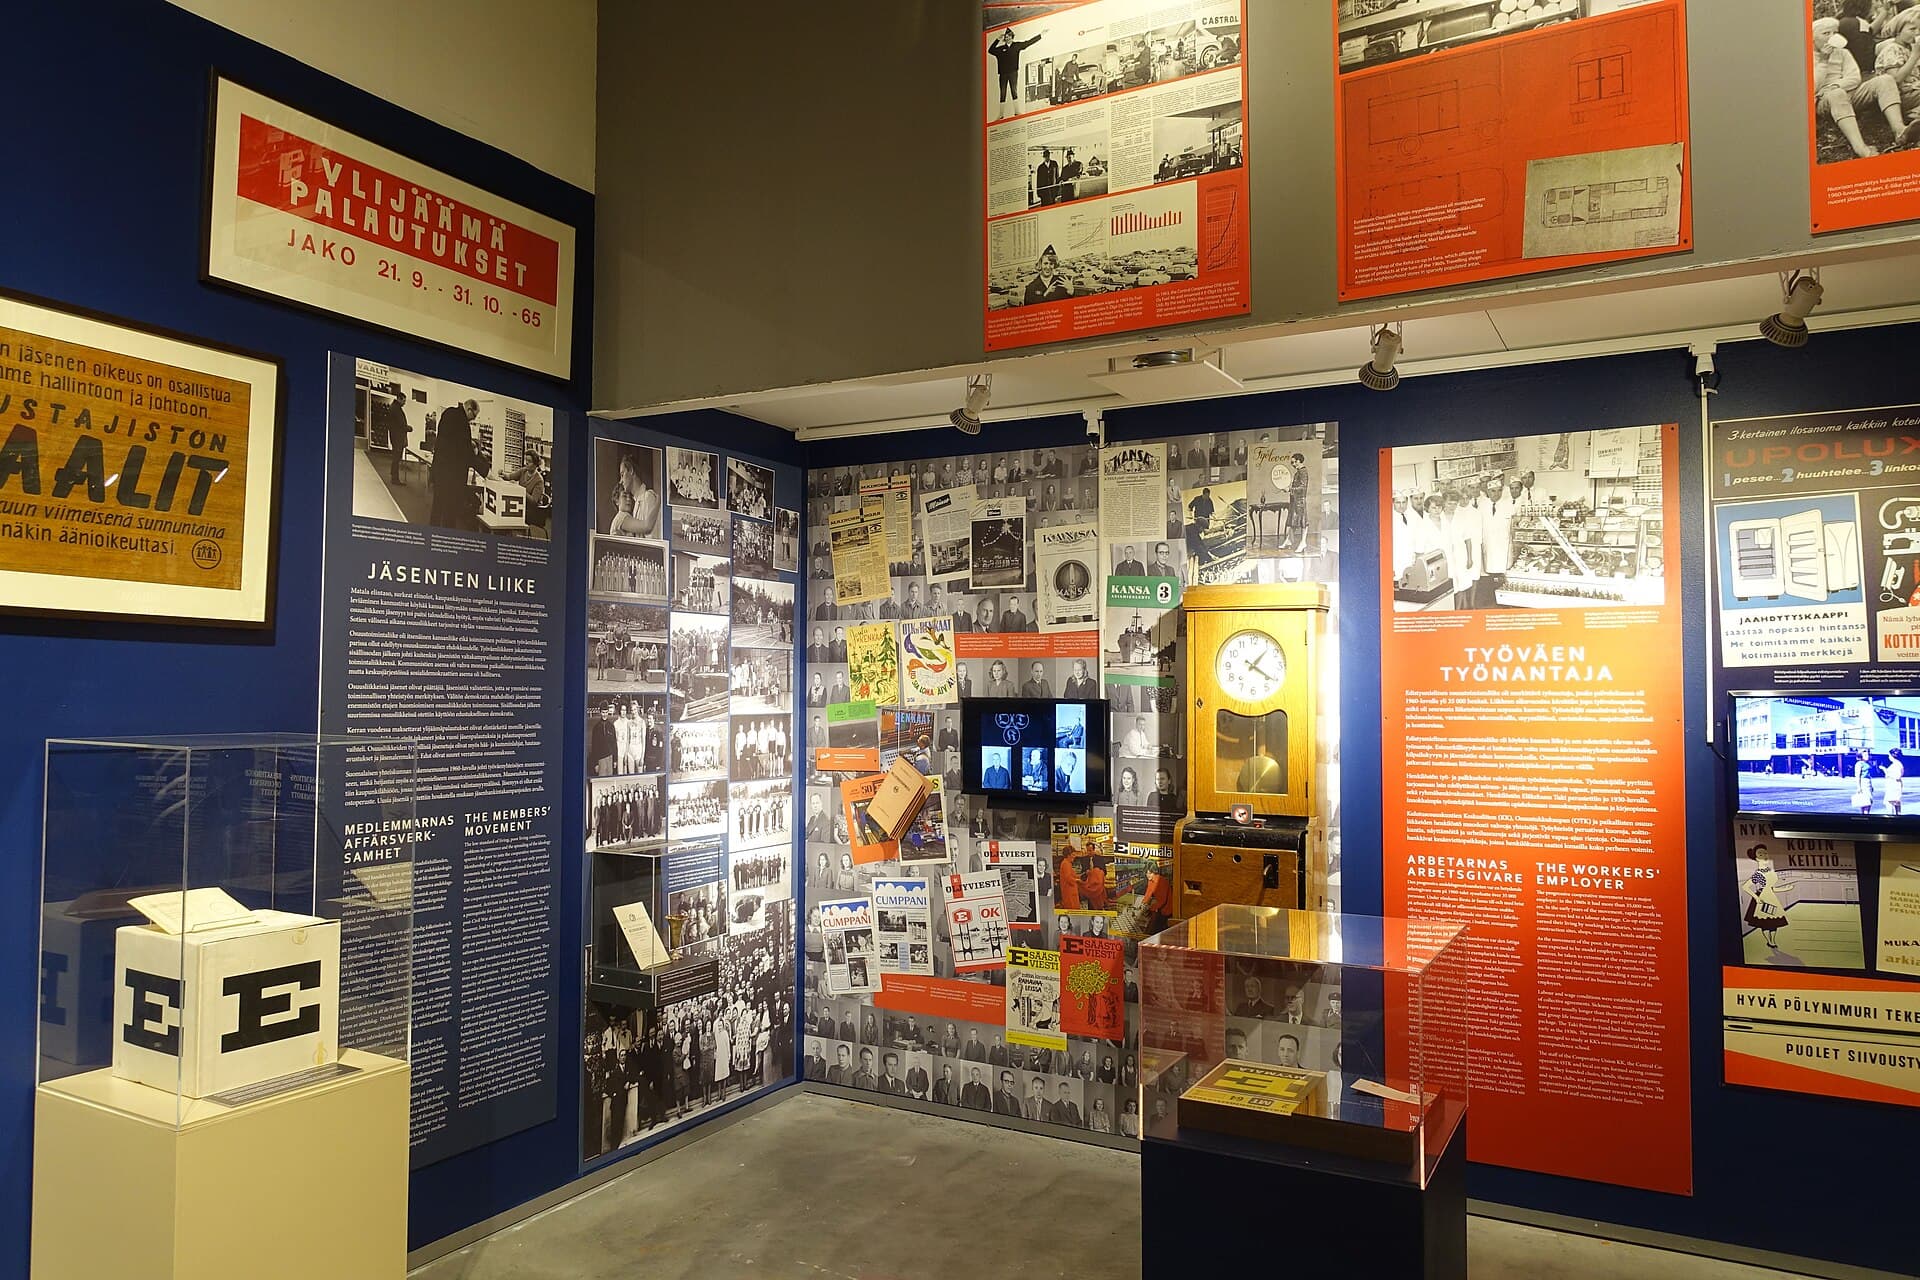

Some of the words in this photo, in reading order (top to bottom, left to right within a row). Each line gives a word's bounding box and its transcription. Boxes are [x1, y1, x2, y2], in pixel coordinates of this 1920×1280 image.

[1201, 15, 1239, 26] CASTROL
[322, 157, 507, 252] YLIJÄÄMÄ
[290, 178, 527, 287] PALAUTUKSET
[288, 229, 356, 266] JAKO
[378, 259, 401, 281] 21.
[412, 271, 428, 291] 9.
[453, 285, 473, 305] 31.
[483, 295, 503, 315] 10.
[19, 344, 86, 373] jäsenen
[93, 363, 143, 385] oikeus
[147, 374, 162, 389] on
[168, 379, 231, 403] osallistua
[357, 361, 388, 376] VAALIT
[40, 371, 123, 402] hallintoon
[130, 391, 143, 406] ja
[149, 392, 212, 420] johtoon.
[1790, 423, 1842, 435] ilosanoma
[1846, 419, 1887, 430] kaikkiin
[1724, 436, 1920, 468] UPOLUX
[0, 423, 230, 516] AALIT
[1781, 468, 1794, 483] 2
[1869, 460, 1883, 476] 3
[485, 486, 497, 514] E
[501, 495, 524, 518] E
[44, 505, 134, 530] viimeisenä
[136, 516, 226, 540] sunnuntaina
[2, 521, 51, 541] näkin
[59, 526, 178, 556] äänioikeuttasi.
[368, 561, 480, 589] JÄSENTEN
[488, 575, 536, 594] LIIKE
[1111, 585, 1151, 595] KANSA
[1159, 586, 1169, 599] 3
[1768, 626, 1814, 635] nopeasti
[1819, 623, 1866, 632] hintansa
[1750, 638, 1815, 647] toimitamme
[1820, 636, 1862, 644] kaikkia
[1464, 644, 1585, 662] TYÖVÄEN
[1741, 651, 1797, 660] kotimaisia
[1440, 664, 1614, 682] TYÖNANTAJA
[344, 815, 455, 836] MEDLEMMARNAS
[465, 812, 488, 824] THE
[465, 820, 532, 837] MOVEMENT
[1052, 822, 1068, 834] E
[1070, 822, 1111, 835] myymälä
[344, 831, 436, 850] AFFÄRSVERK-
[1787, 839, 1834, 851] KODIN
[344, 847, 401, 864] SAMHET
[1130, 846, 1173, 859] myymälä
[1407, 854, 1508, 870] ARBETARNAS
[1536, 862, 1566, 874] THE
[1407, 866, 1524, 884] ARBETSGIVARE
[1536, 874, 1625, 890] EMPLOYER
[876, 895, 927, 906] CUMPPANI
[823, 915, 872, 927] CUMPPANI
[956, 912, 968, 921] E
[980, 907, 1000, 919] OK
[1063, 938, 1083, 955] E
[1085, 948, 1116, 960] VIESTI
[1008, 949, 1029, 967] E
[1029, 951, 1060, 962] SÄÄST
[1029, 959, 1059, 970] VIESTI
[123, 967, 186, 1057] E
[221, 959, 322, 1054] E
[1737, 993, 1777, 1009] HYVÄ
[1784, 995, 1878, 1019] PÖLYNIMURI
[1786, 1043, 1840, 1060] PUOLET
